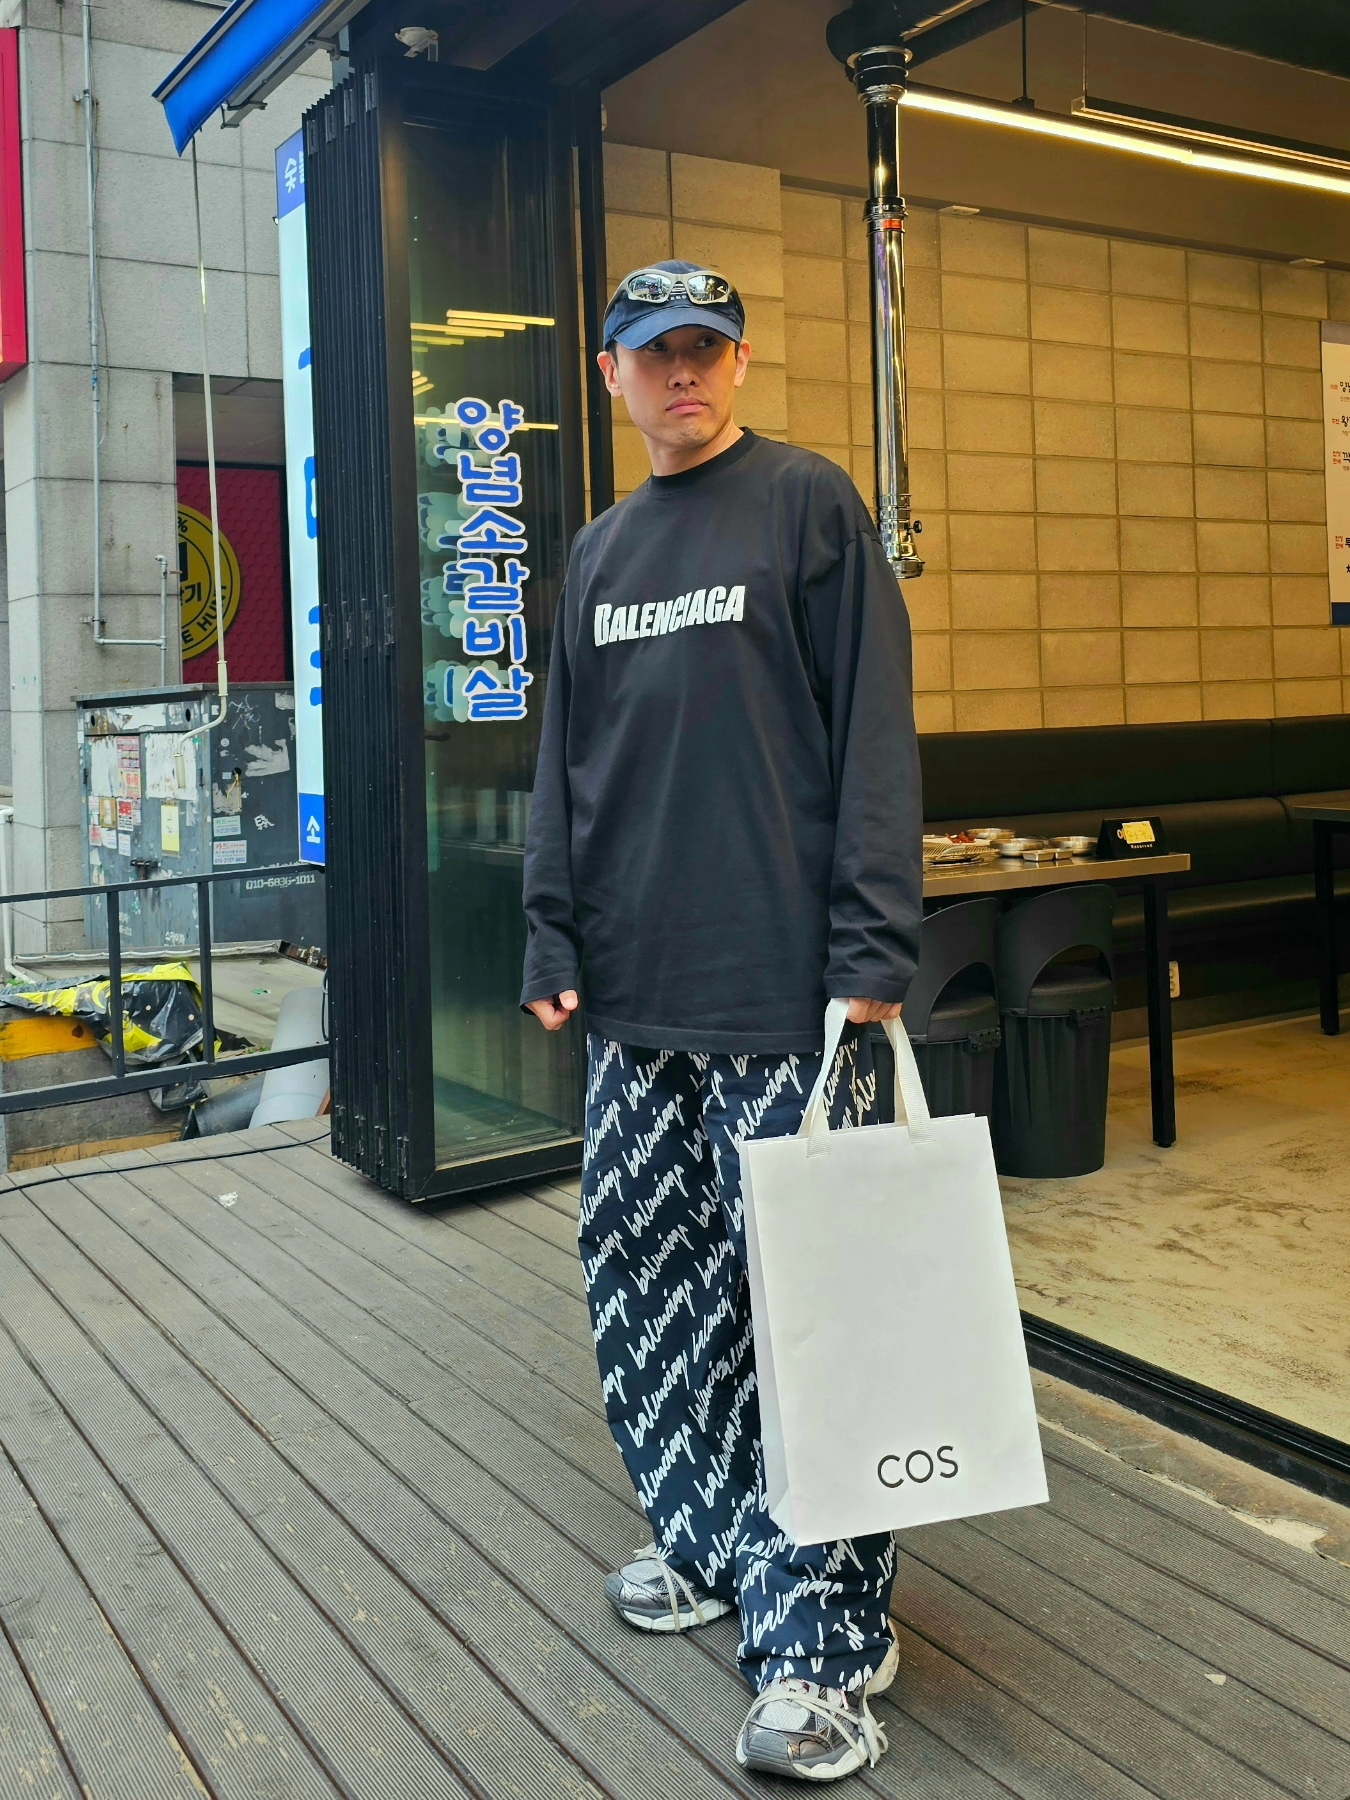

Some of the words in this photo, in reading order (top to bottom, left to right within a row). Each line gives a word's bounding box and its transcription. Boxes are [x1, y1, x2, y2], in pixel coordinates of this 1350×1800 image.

[454, 397, 533, 721] 양념소갈비살
[594, 585, 746, 647] BALENCIAGA
[622, 1094, 685, 1179] balenciaga
[623, 1164, 689, 1238] balenciaga
[629, 1224, 695, 1296] balenciaga
[626, 1279, 696, 1371] balenciaga
[877, 1445, 959, 1488] COS
